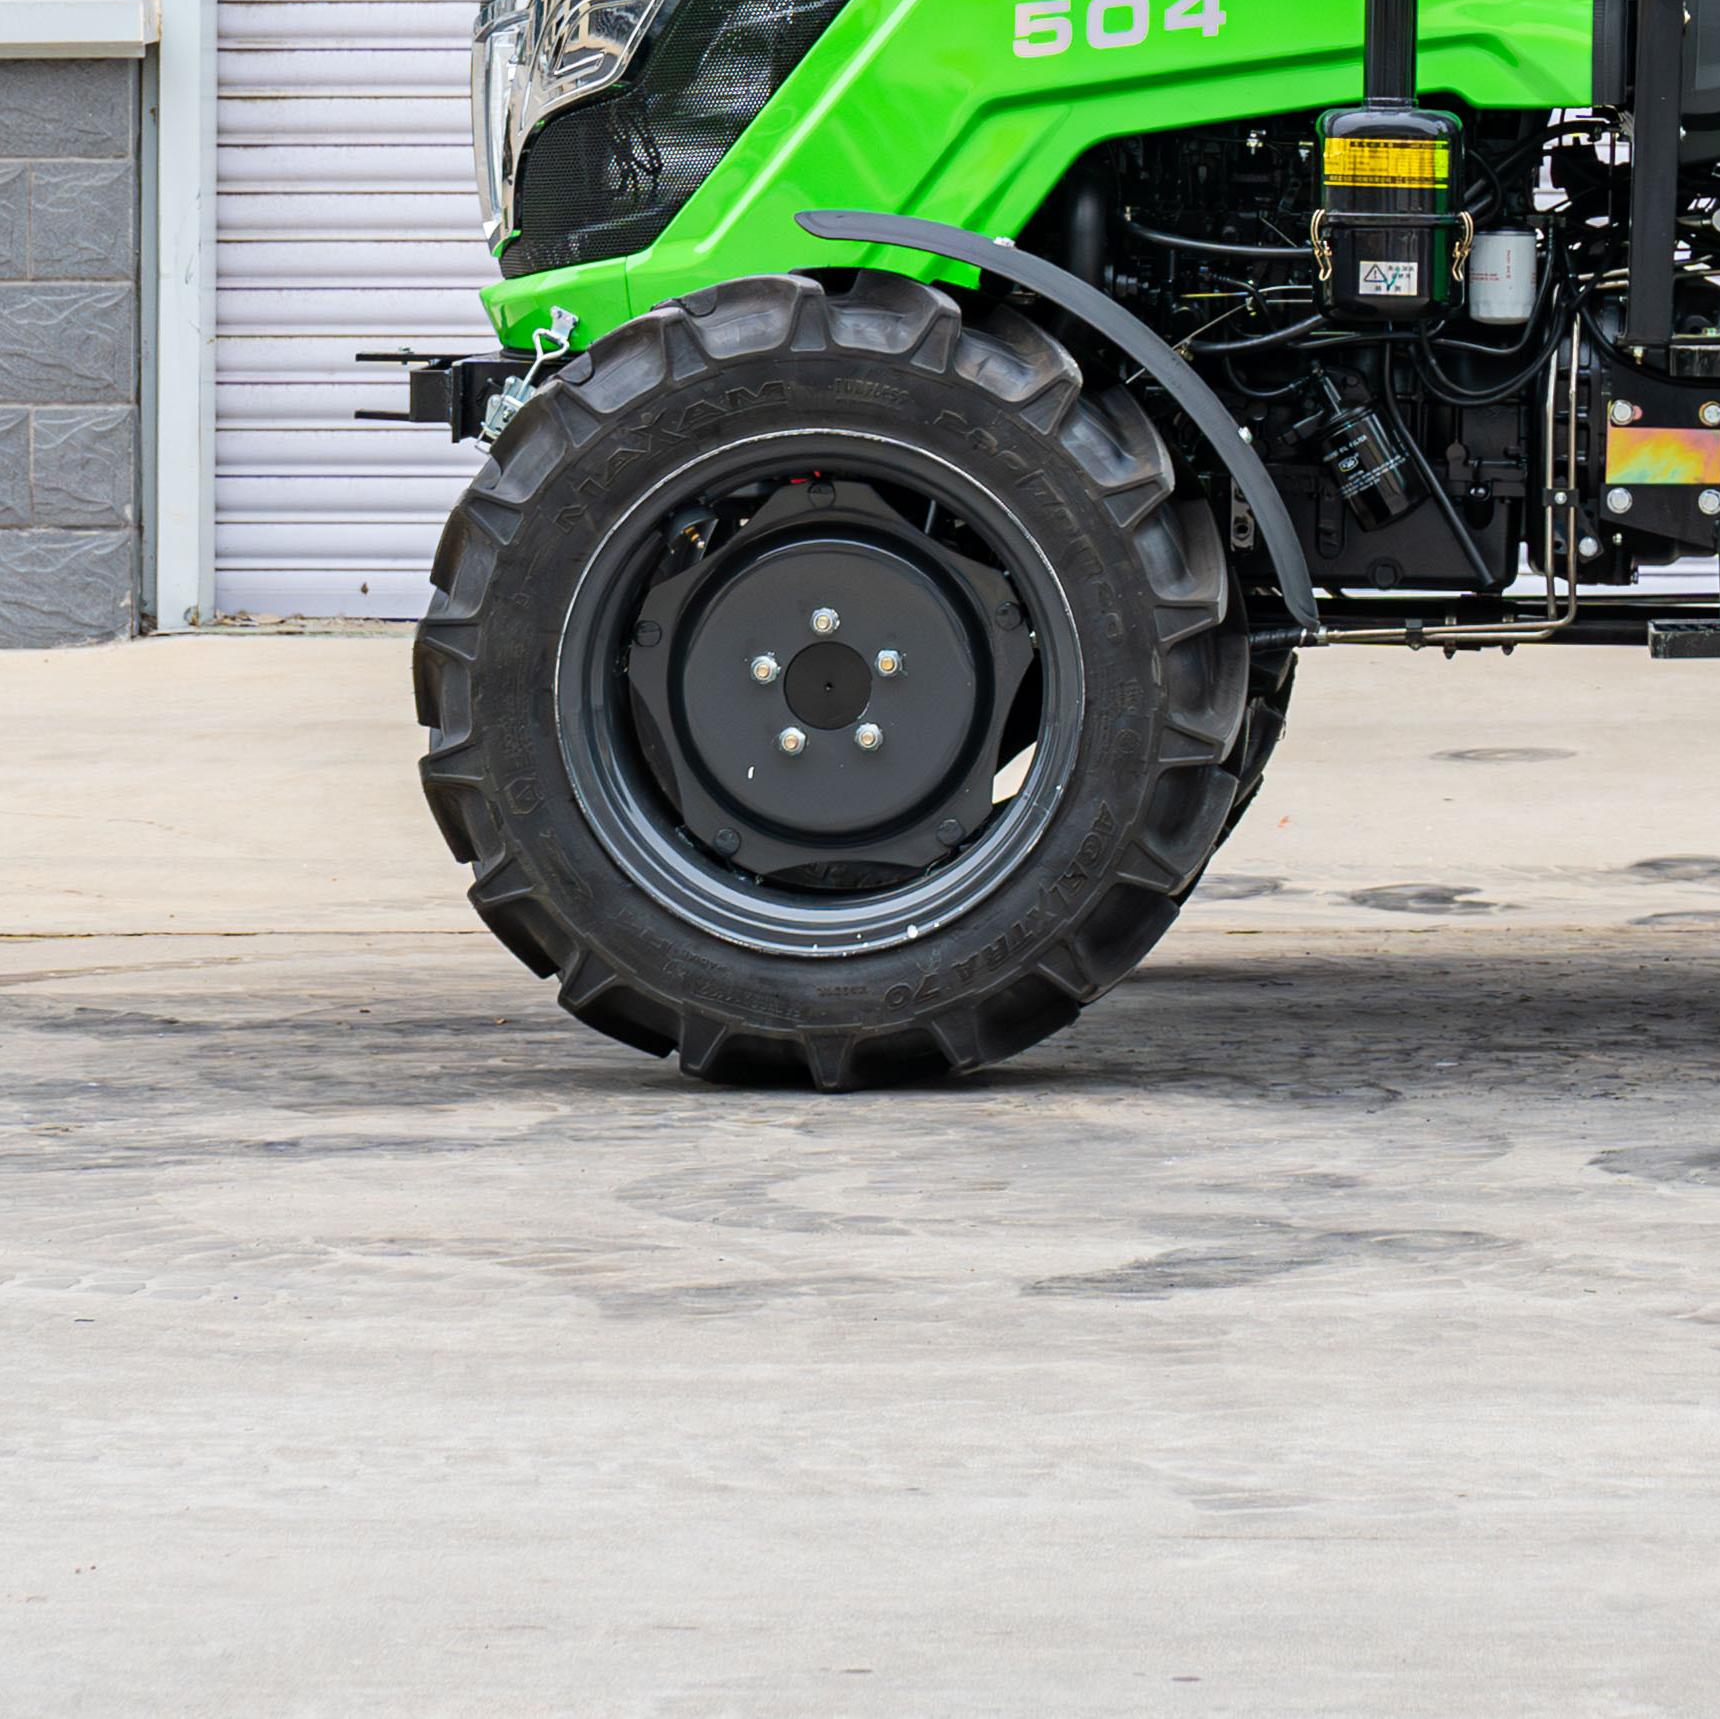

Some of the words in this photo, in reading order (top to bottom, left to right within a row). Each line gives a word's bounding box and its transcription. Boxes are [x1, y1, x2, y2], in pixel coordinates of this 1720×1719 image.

[551, 379, 789, 532] MAXAM
[951, 800, 1114, 991] AGRIXTRA
[885, 969, 950, 1012] 70
